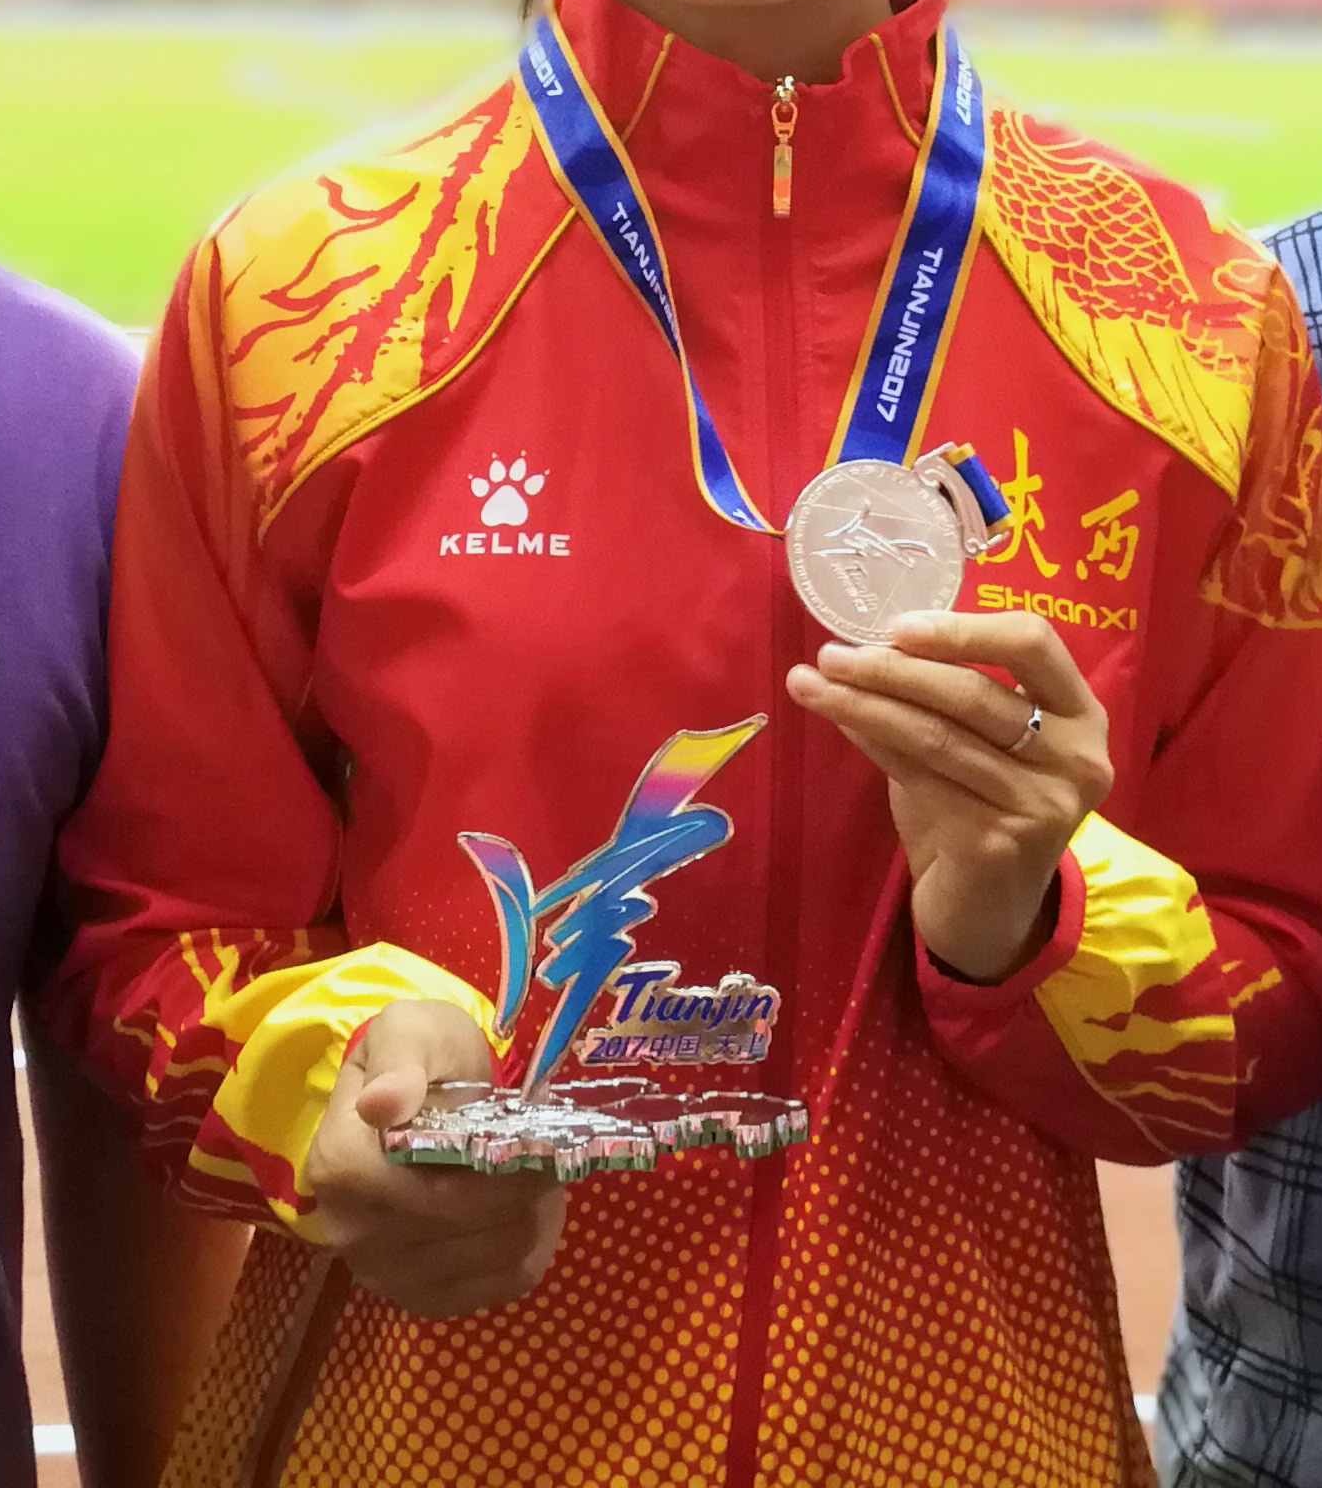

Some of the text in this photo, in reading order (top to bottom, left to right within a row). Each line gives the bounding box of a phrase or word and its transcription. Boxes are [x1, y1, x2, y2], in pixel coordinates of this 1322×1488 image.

[877, 247, 944, 422] TIANJIN2017
[439, 532, 571, 557] KELME
[613, 969, 774, 1031] Tianjin
